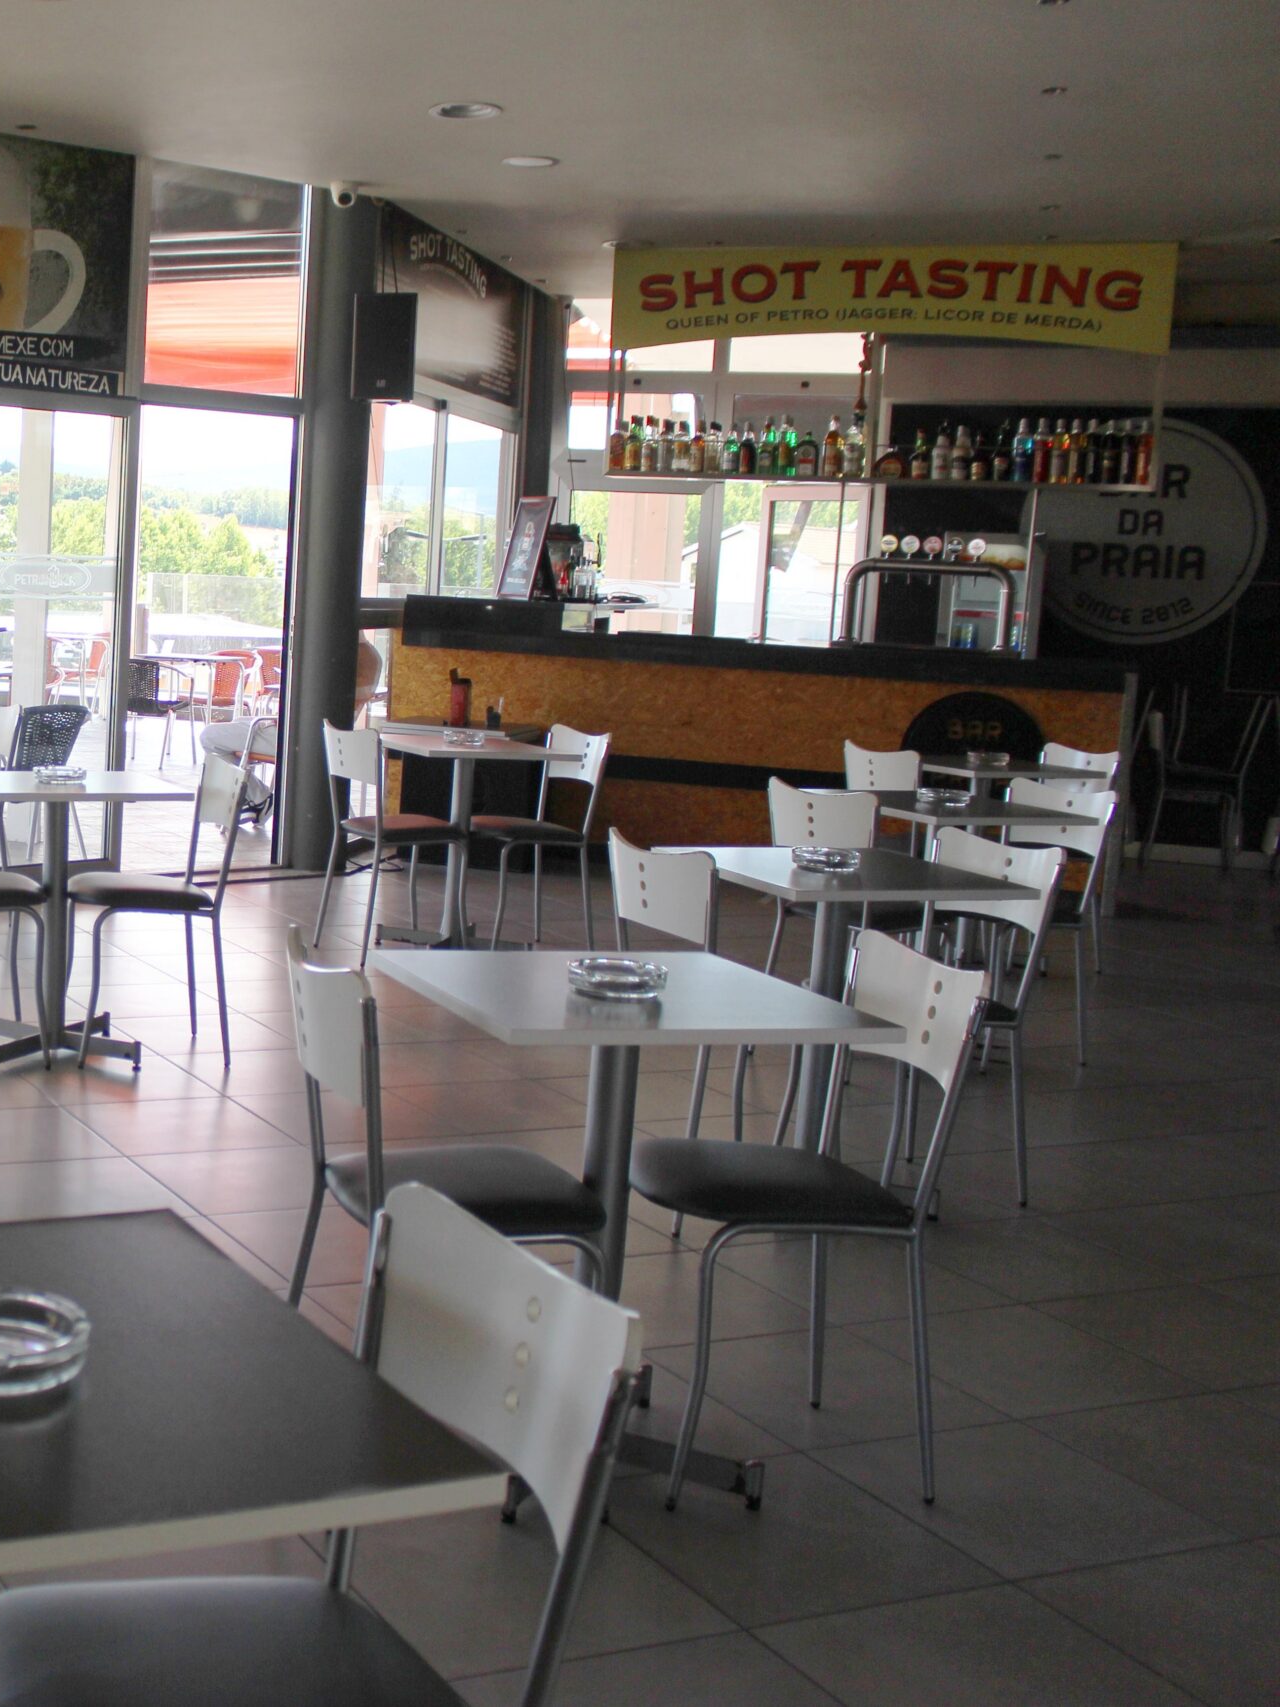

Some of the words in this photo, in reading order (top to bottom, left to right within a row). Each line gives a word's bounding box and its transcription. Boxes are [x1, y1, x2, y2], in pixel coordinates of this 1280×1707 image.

[410, 233, 442, 260] SHOT
[446, 237, 487, 299] TASTING
[639, 260, 820, 312] SHOT
[841, 258, 1144, 312] TASTING
[665, 314, 729, 331] QUEEN
[735, 311, 760, 325] OF
[767, 308, 829, 322] PETRO
[924, 308, 984, 322] LICOR
[991, 311, 1018, 325] DE
[1024, 313, 1103, 333] MERDA)
[40, 337, 74, 359] COM
[25, 366, 110, 395] NATUREZA
[1118, 508, 1164, 536] DA
[1072, 542, 1206, 581] PRAIA
